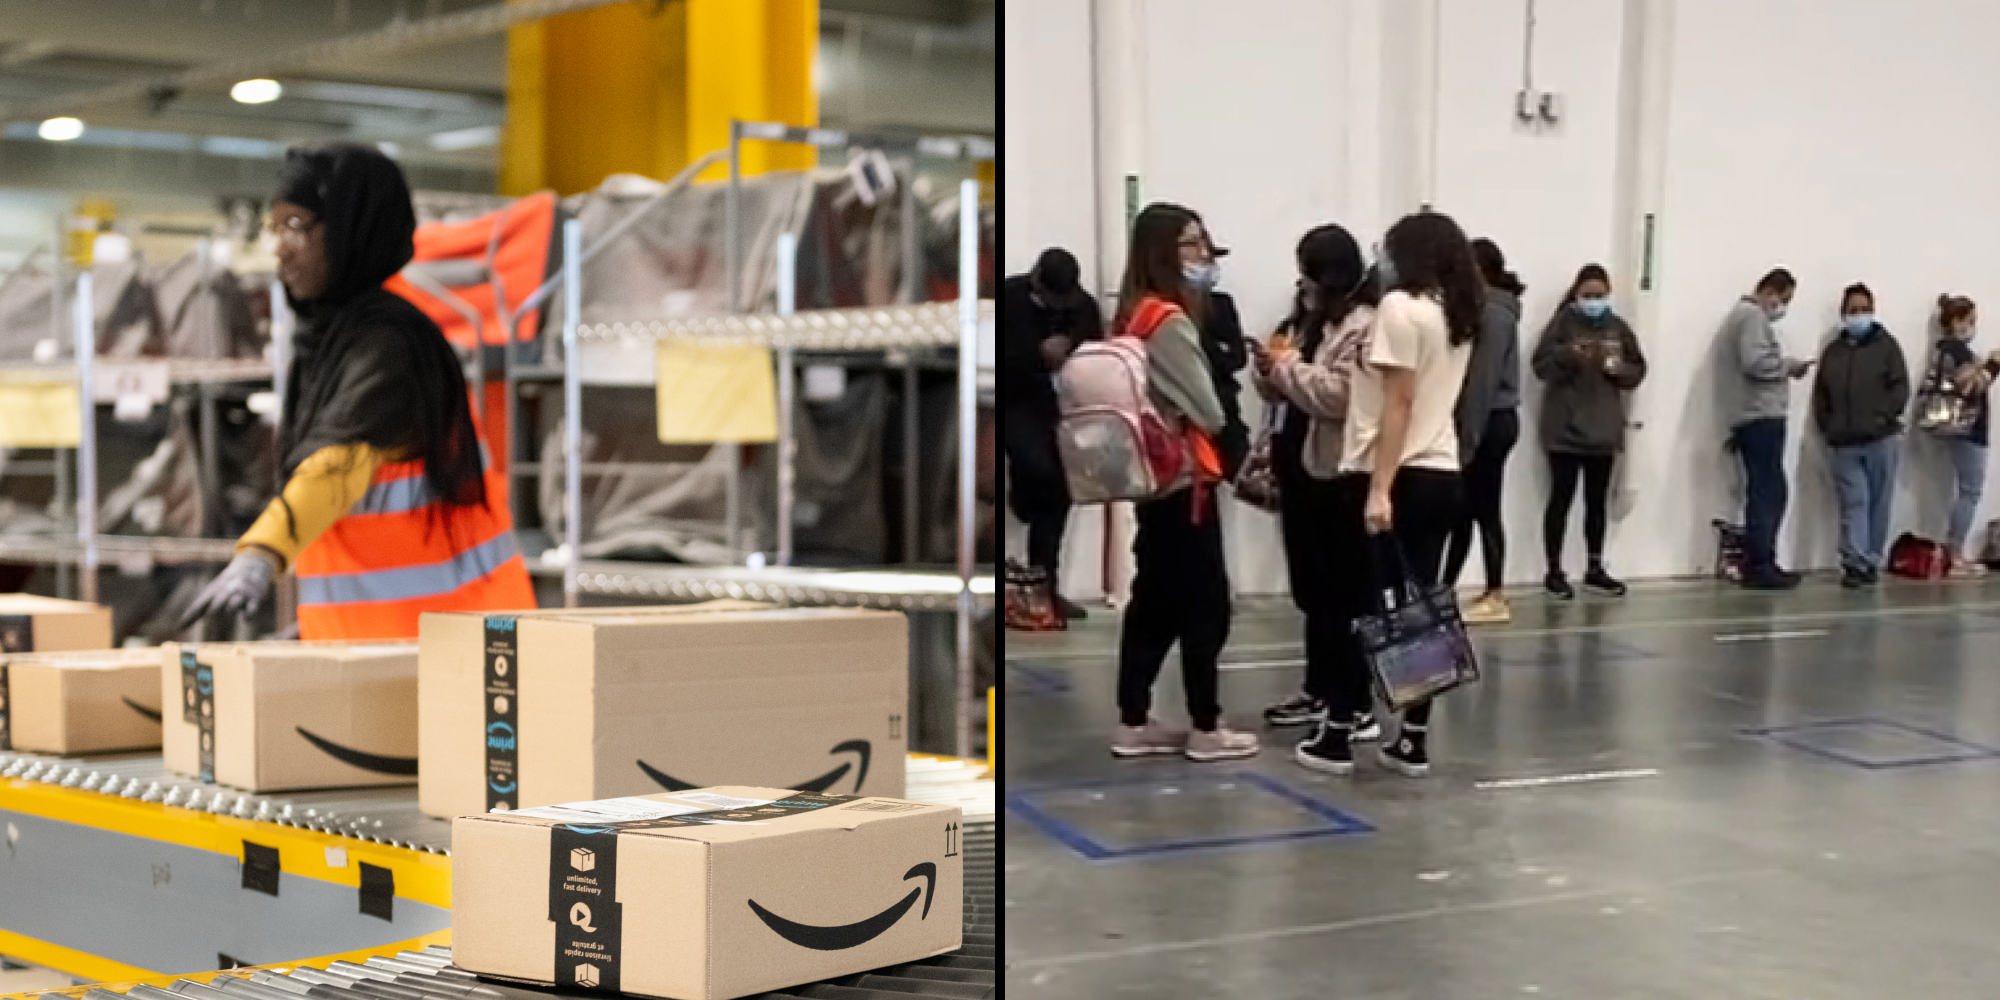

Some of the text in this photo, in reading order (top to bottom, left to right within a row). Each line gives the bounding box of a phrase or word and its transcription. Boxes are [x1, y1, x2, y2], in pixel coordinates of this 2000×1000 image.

[487, 735, 515, 752] prime
[567, 875, 598, 885] unlimited,
[576, 885, 601, 895] delivery
[572, 941, 596, 950] gratuite
[565, 949, 611, 962] livraison rapide
